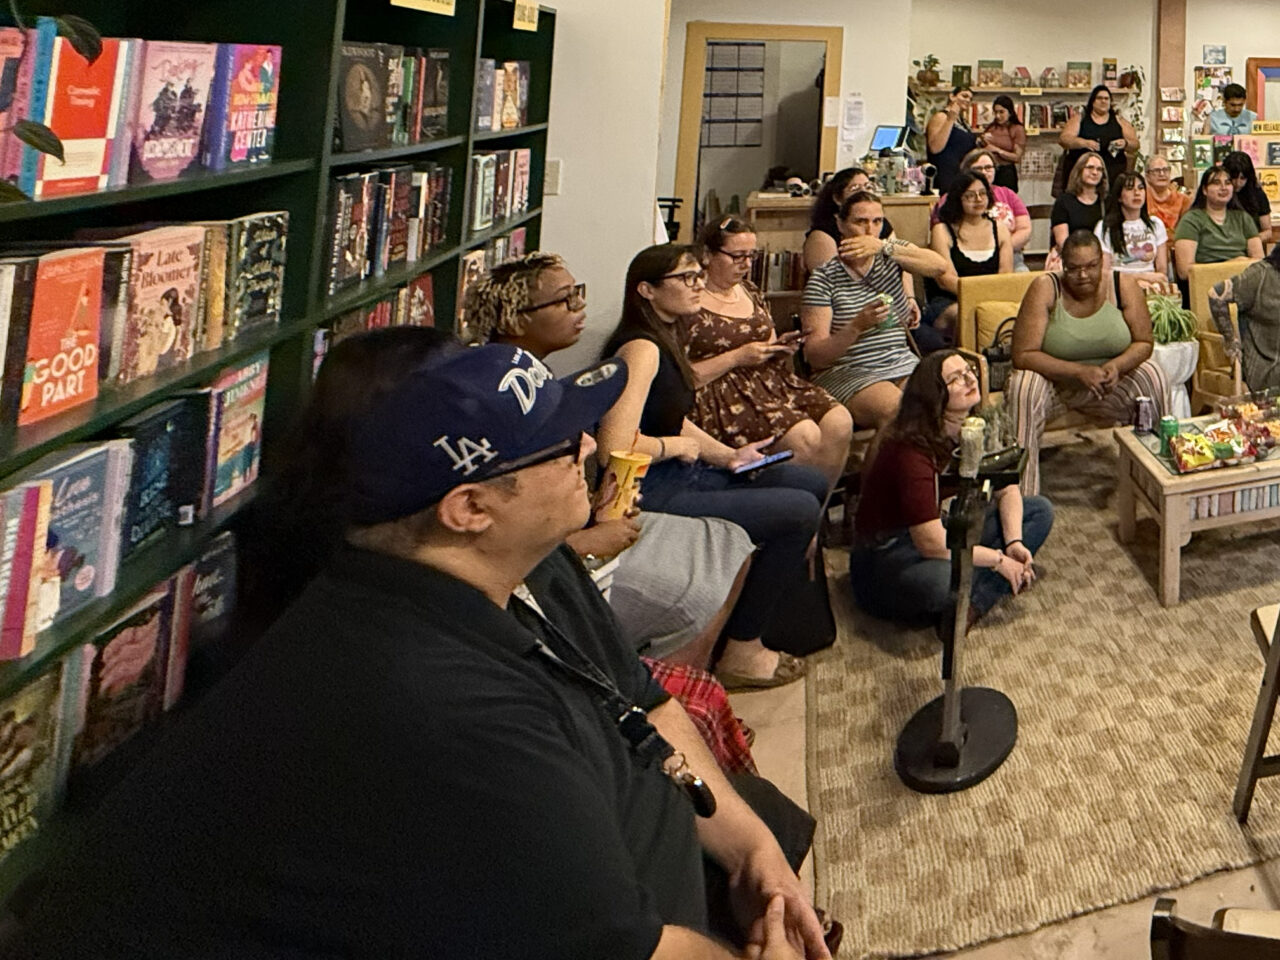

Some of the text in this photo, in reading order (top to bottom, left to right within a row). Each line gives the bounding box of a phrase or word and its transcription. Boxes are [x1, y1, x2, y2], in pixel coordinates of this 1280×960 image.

[157, 249, 184, 266] Late
[141, 267, 191, 289] Bloomer
[33, 343, 96, 384] GOOD
[41, 370, 86, 407] PART
[433, 435, 499, 476] LA
